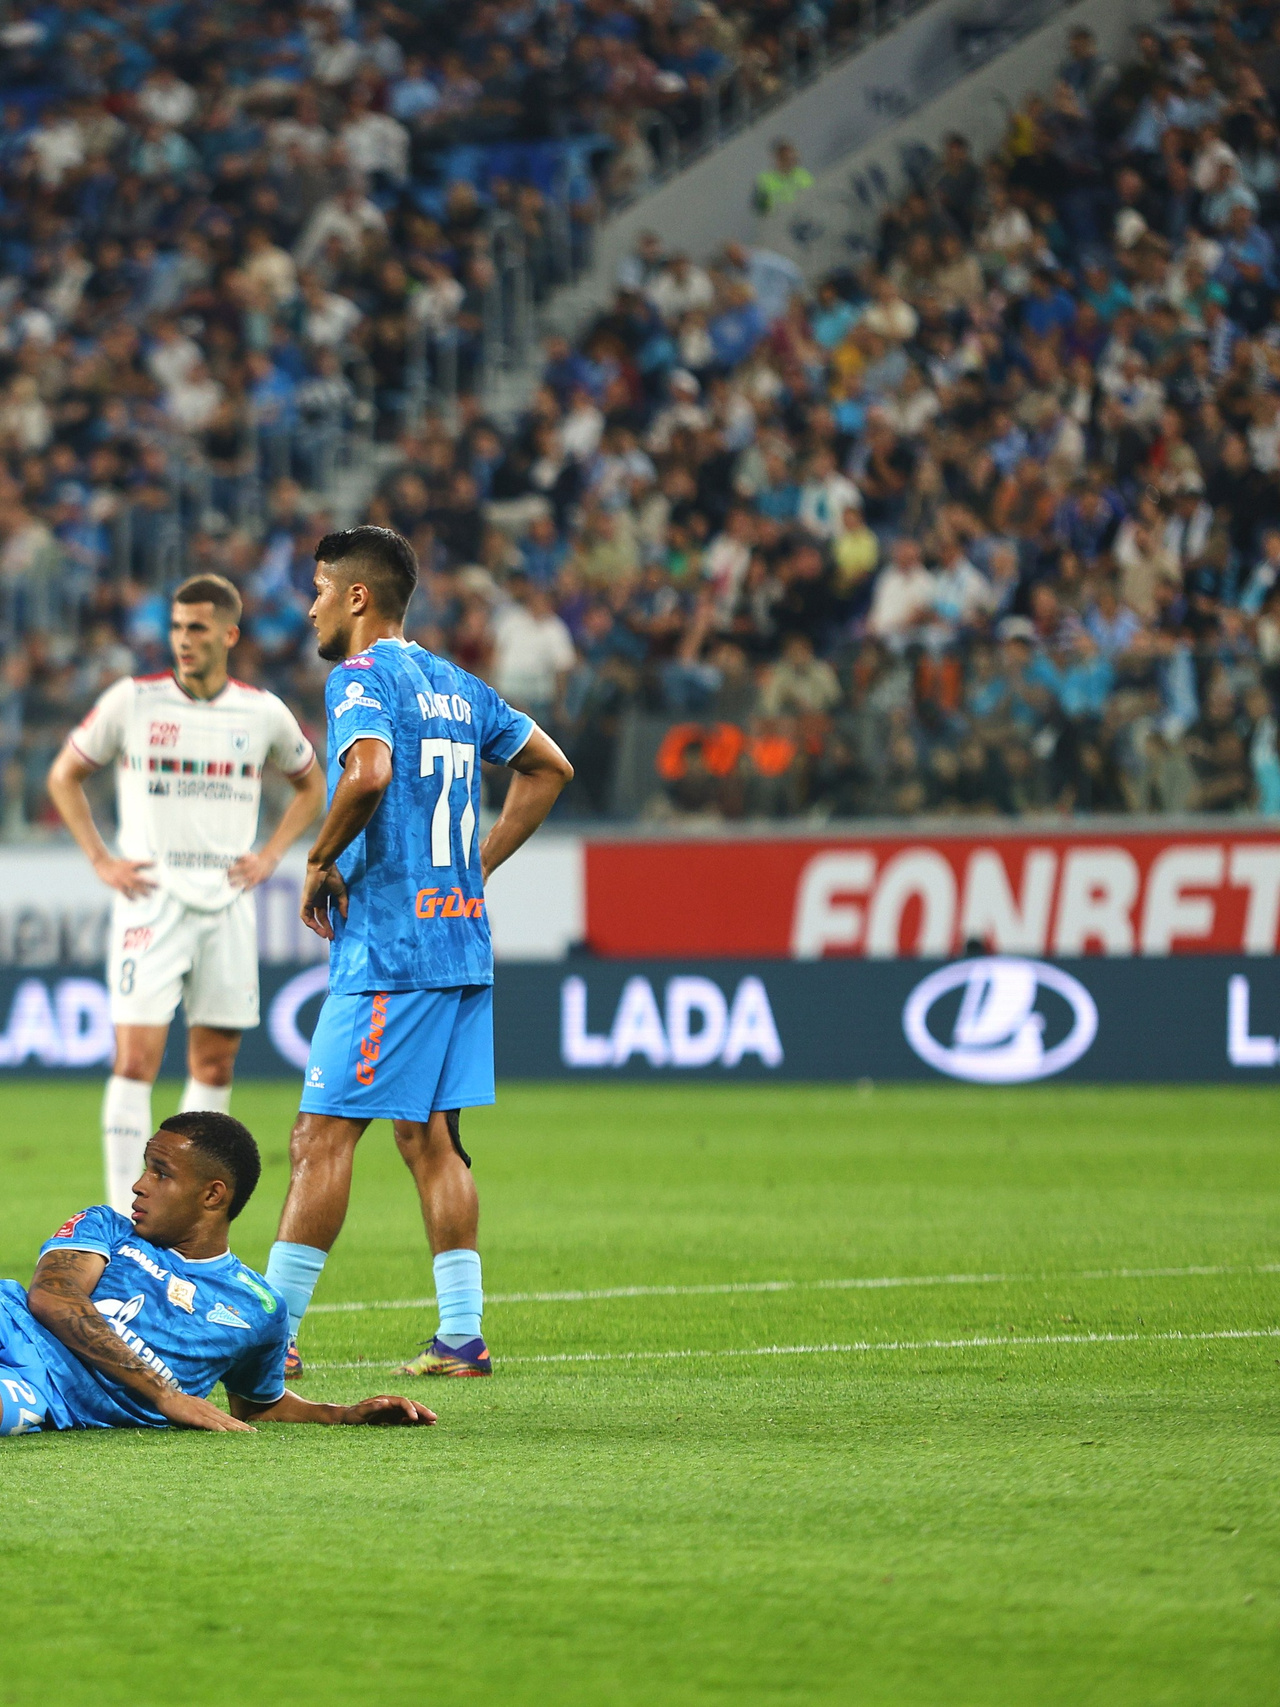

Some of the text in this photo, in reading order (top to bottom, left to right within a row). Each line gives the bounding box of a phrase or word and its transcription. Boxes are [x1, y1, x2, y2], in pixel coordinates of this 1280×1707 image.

[416, 690, 472, 725] АХТОВ
[149, 721, 181, 734] FON
[149, 734, 178, 748] BET
[420, 737, 476, 870] 77
[119, 958, 136, 995] 8
[356, 991, 391, 1086] G-ENER
[560, 975, 784, 1068] LADA
[117, 1244, 169, 1281] KAMAZ
[122, 1328, 188, 1395] ГАЗПР
